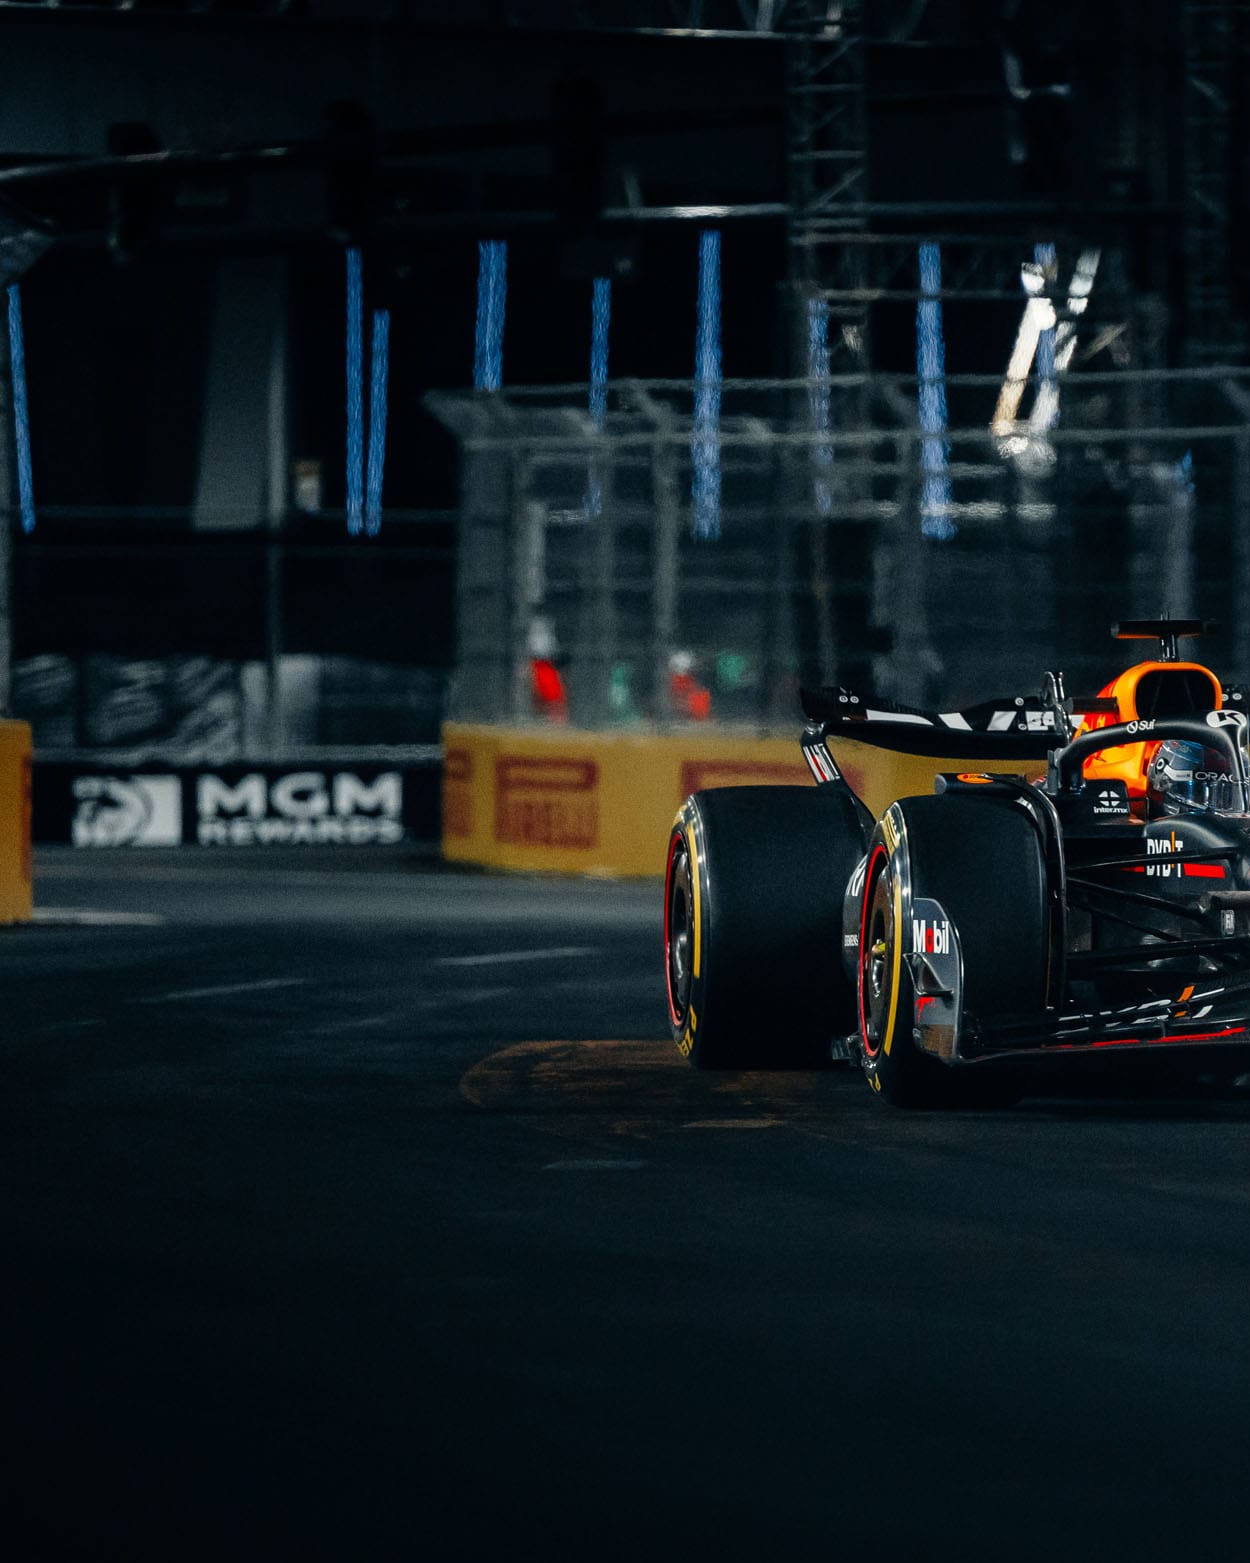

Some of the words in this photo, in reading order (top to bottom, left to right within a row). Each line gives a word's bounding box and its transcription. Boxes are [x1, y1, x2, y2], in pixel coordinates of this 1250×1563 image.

[197, 772, 402, 817] MGM
[197, 818, 402, 846] REWARDS
[912, 919, 949, 954] Mobil
